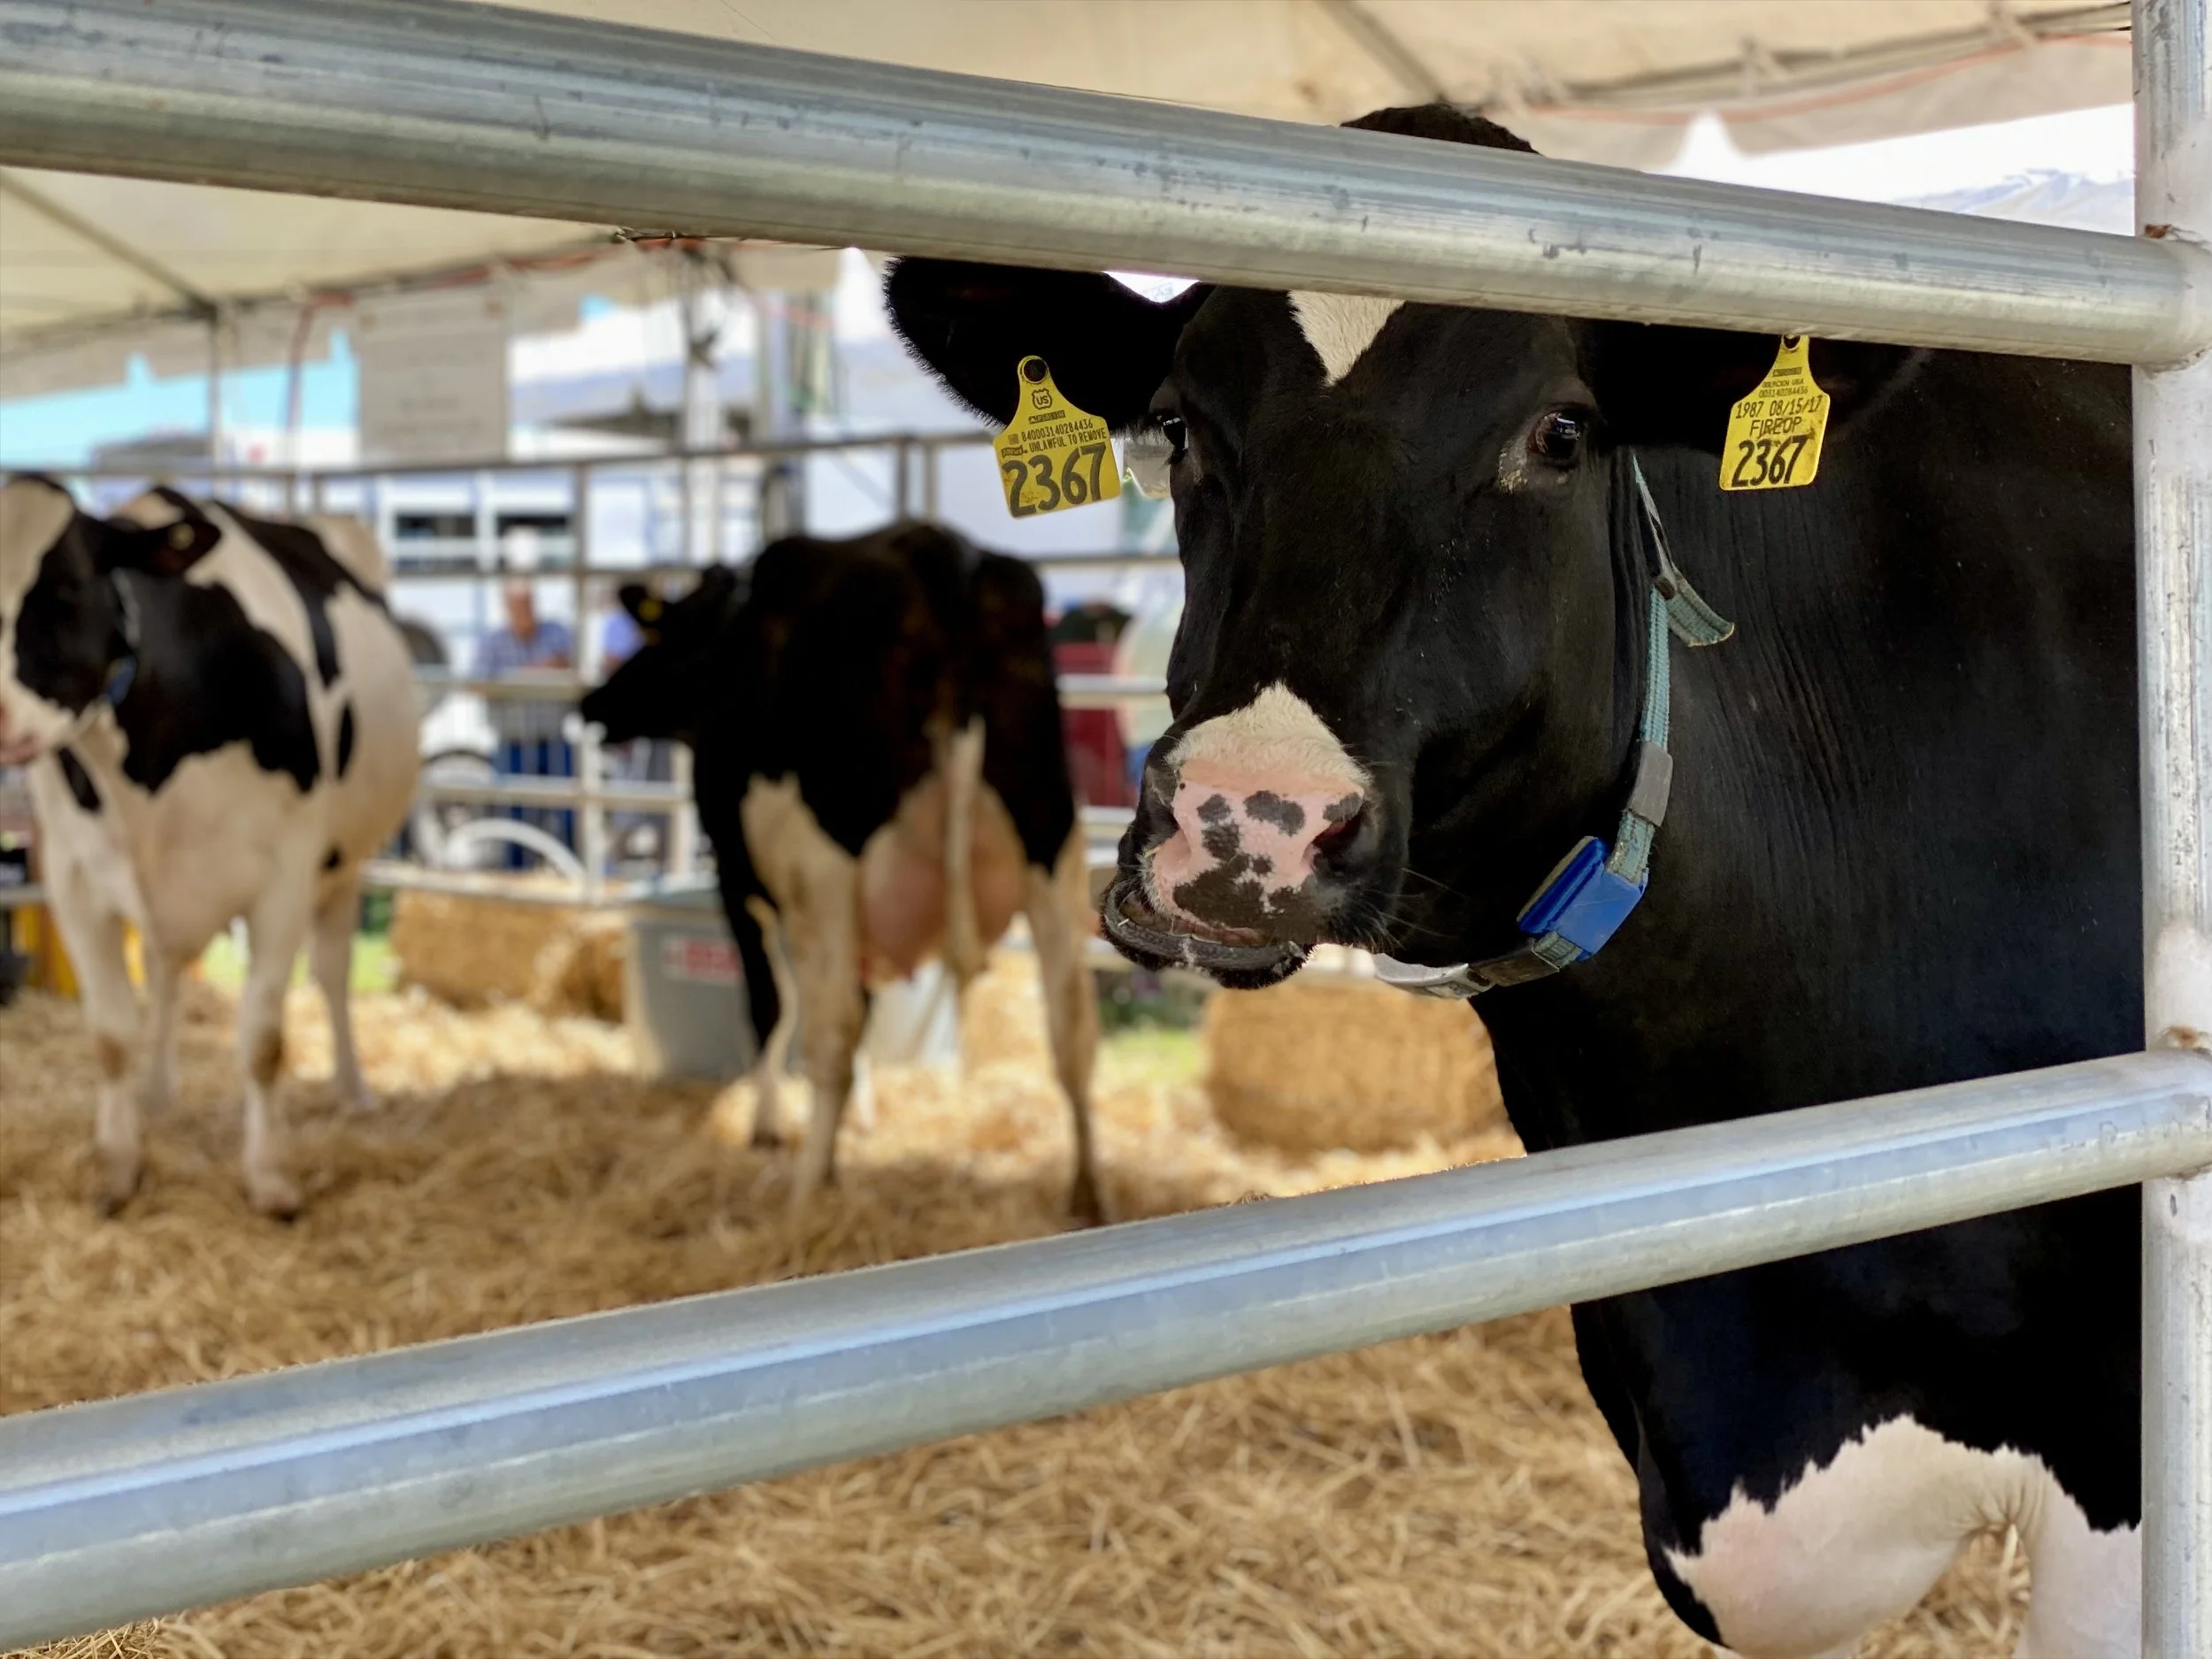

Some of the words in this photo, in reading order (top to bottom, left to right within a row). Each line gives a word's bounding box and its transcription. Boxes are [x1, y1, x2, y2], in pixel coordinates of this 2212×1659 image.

[1036, 395, 1049, 405] US
[1735, 401, 1764, 419] 1987
[1769, 395, 1823, 417] 08/15/17
[1021, 419, 1094, 442] 840003140284436
[1029, 437, 1067, 453] UNLAWFUL
[1068, 434, 1078, 445] TO
[1079, 427, 1107, 443] REMOVE
[1732, 434, 1809, 488] 2367
[1002, 442, 1106, 517] 2367
